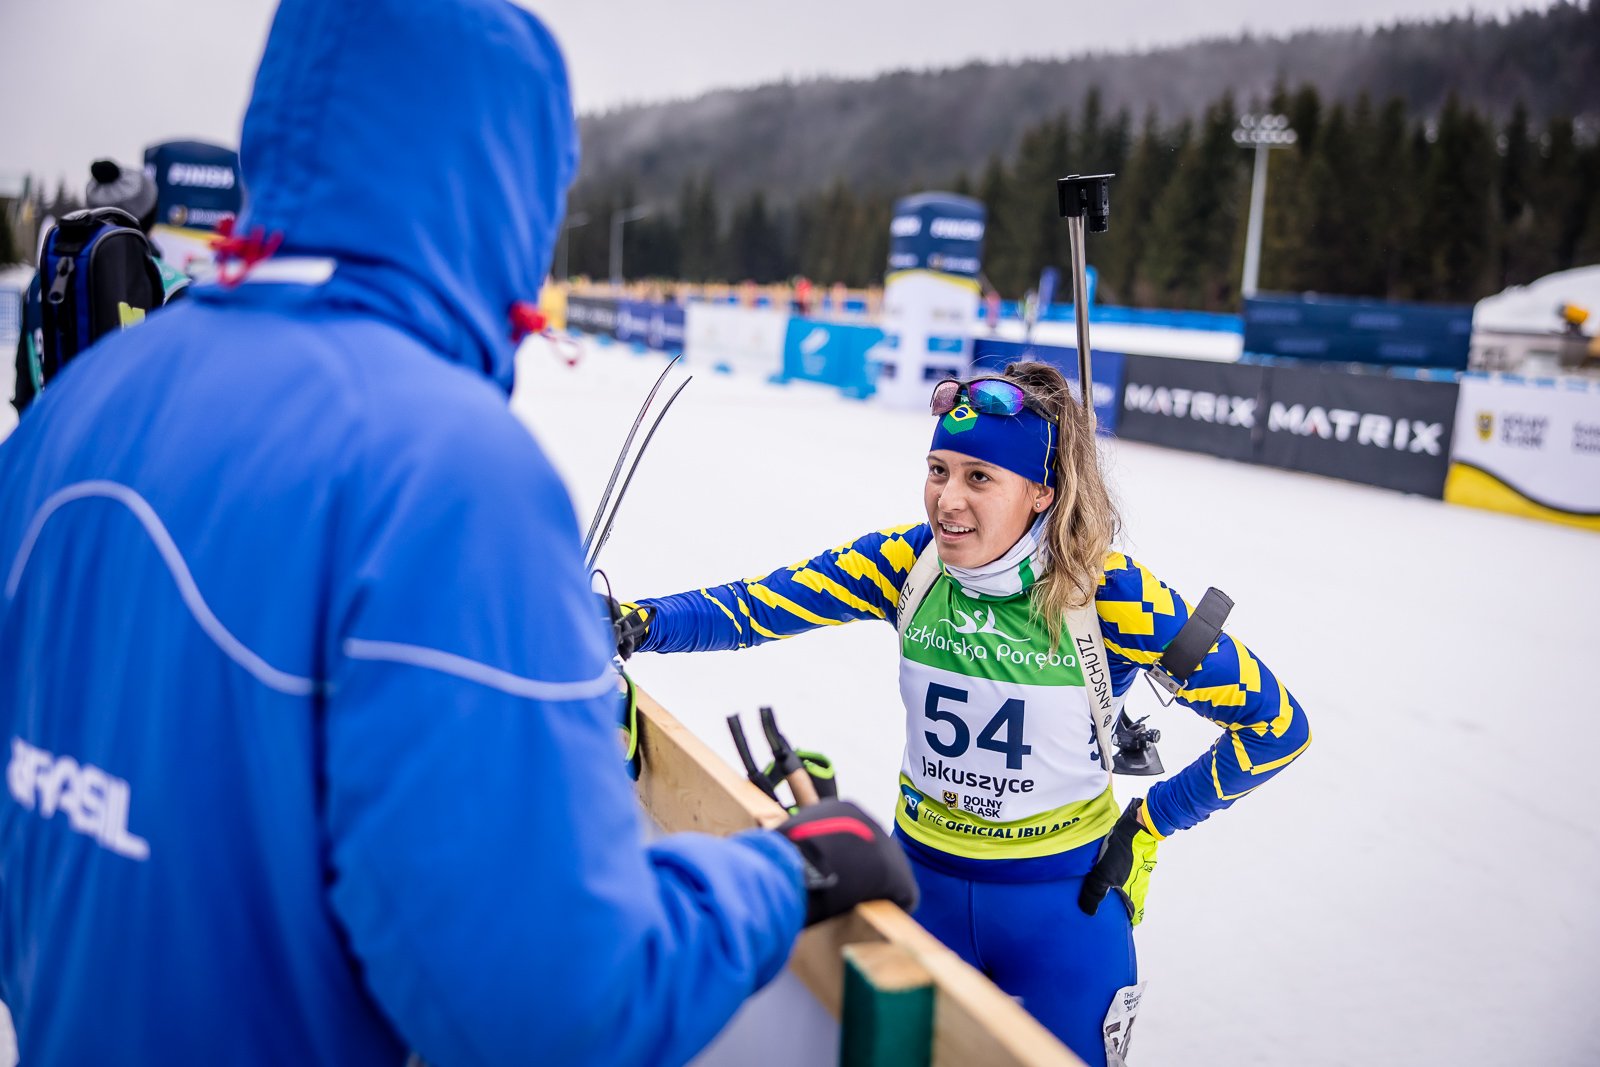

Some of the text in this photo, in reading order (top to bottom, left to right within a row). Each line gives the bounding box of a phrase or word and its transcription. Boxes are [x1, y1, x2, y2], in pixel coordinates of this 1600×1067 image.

[1124, 383, 1257, 428] MATRIX
[1268, 401, 1444, 456] MATRIX
[1076, 634, 1112, 710] ANSCHÜTZ
[924, 682, 1032, 770] 54
[922, 756, 1035, 797] Jakuszyce
[923, 808, 946, 827] THE
[945, 820, 1014, 839] OFFICIAL
[1017, 825, 1046, 838] IBU
[964, 795, 1003, 809] DOLNY
